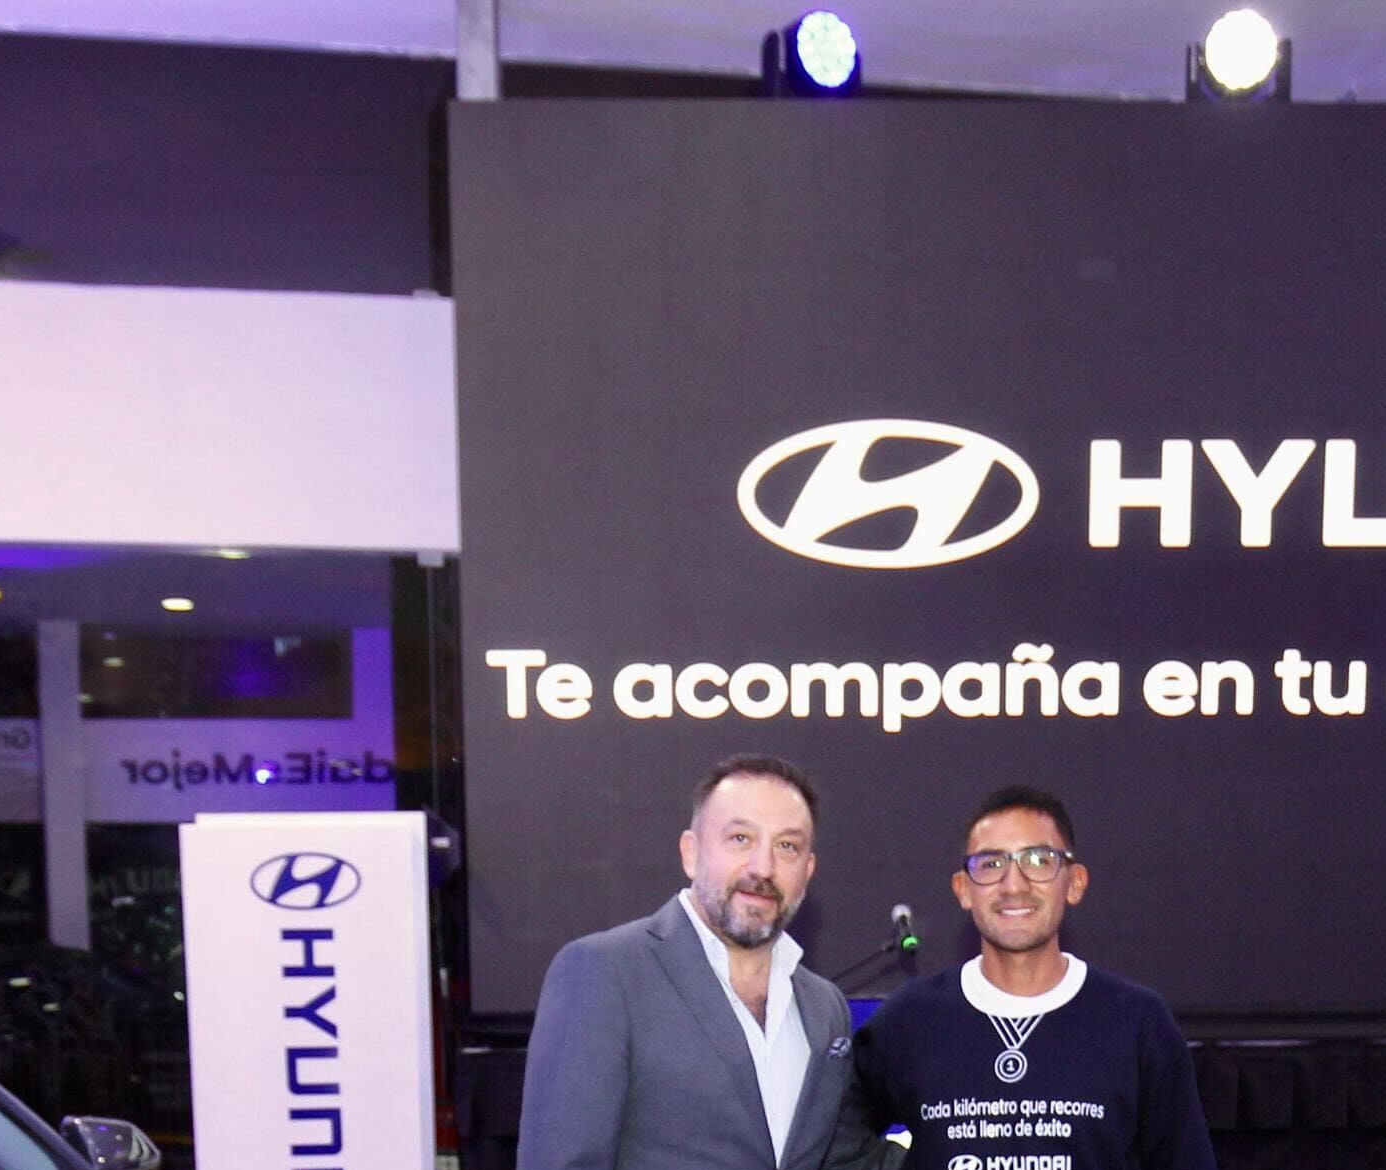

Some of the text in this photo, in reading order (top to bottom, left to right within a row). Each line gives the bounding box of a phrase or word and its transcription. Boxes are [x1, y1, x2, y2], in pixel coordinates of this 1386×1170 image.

[485, 648, 593, 720] Te
[612, 642, 1120, 733] acompaña
[1142, 660, 1255, 717] en
[1274, 648, 1367, 716] tu
[920, 1097, 1105, 1121] Cada kilómetro que recorres
[947, 1117, 1072, 1140] está lleno de éxito
